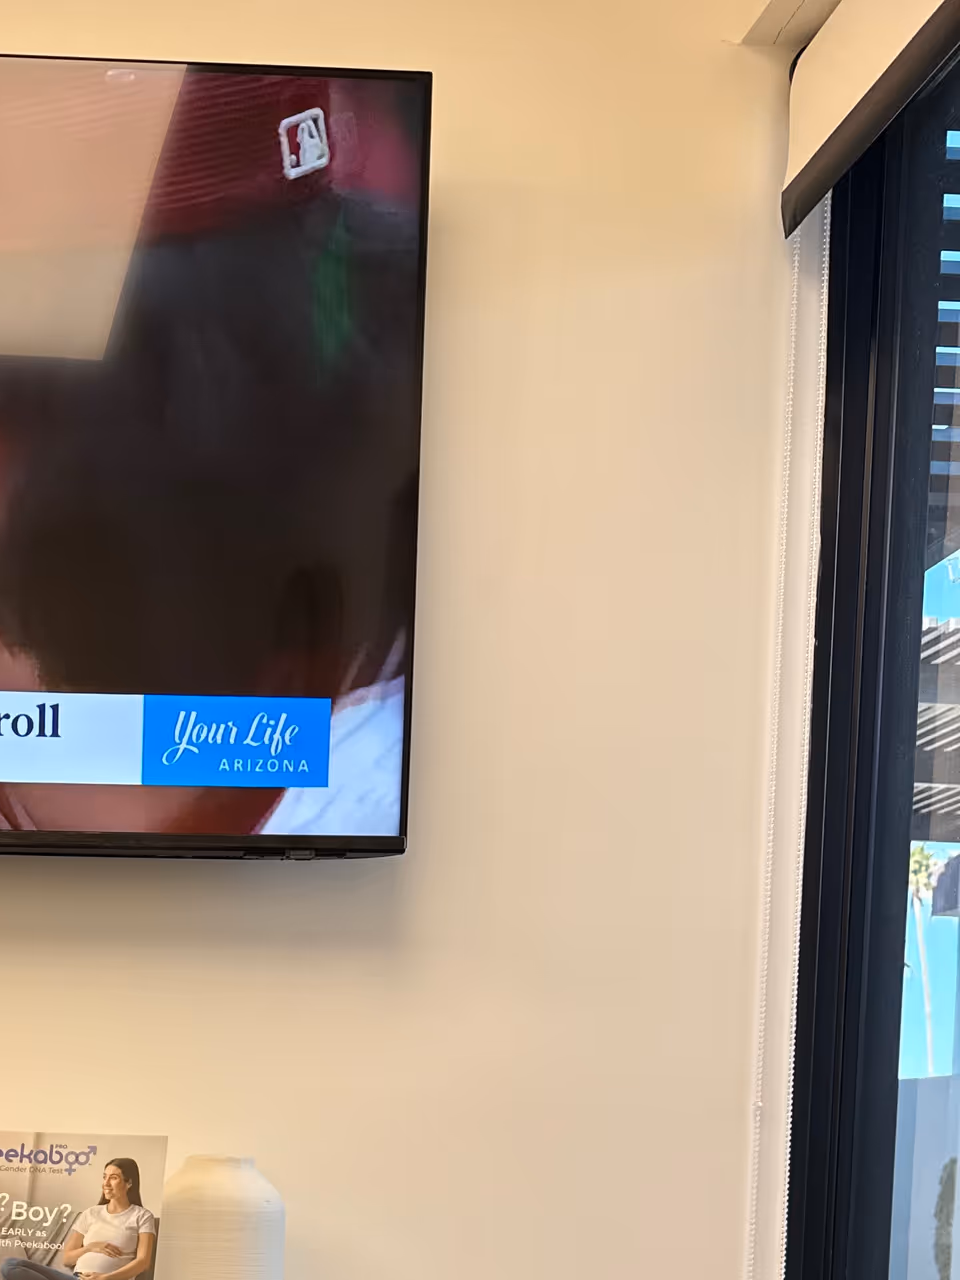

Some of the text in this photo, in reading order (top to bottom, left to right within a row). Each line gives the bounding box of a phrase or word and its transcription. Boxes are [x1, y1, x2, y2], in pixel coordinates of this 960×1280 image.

[162, 711, 300, 766] Your Life
[218, 758, 310, 773] ARIZONA
[0, 1165, 27, 1173] Gender
[29, 1166, 47, 1174] DNA
[10, 1200, 72, 1227] Boy?
[1, 1227, 34, 1237] EARLY
[35, 1230, 47, 1238] as
[14, 1239, 65, 1250] Peekaboo!
